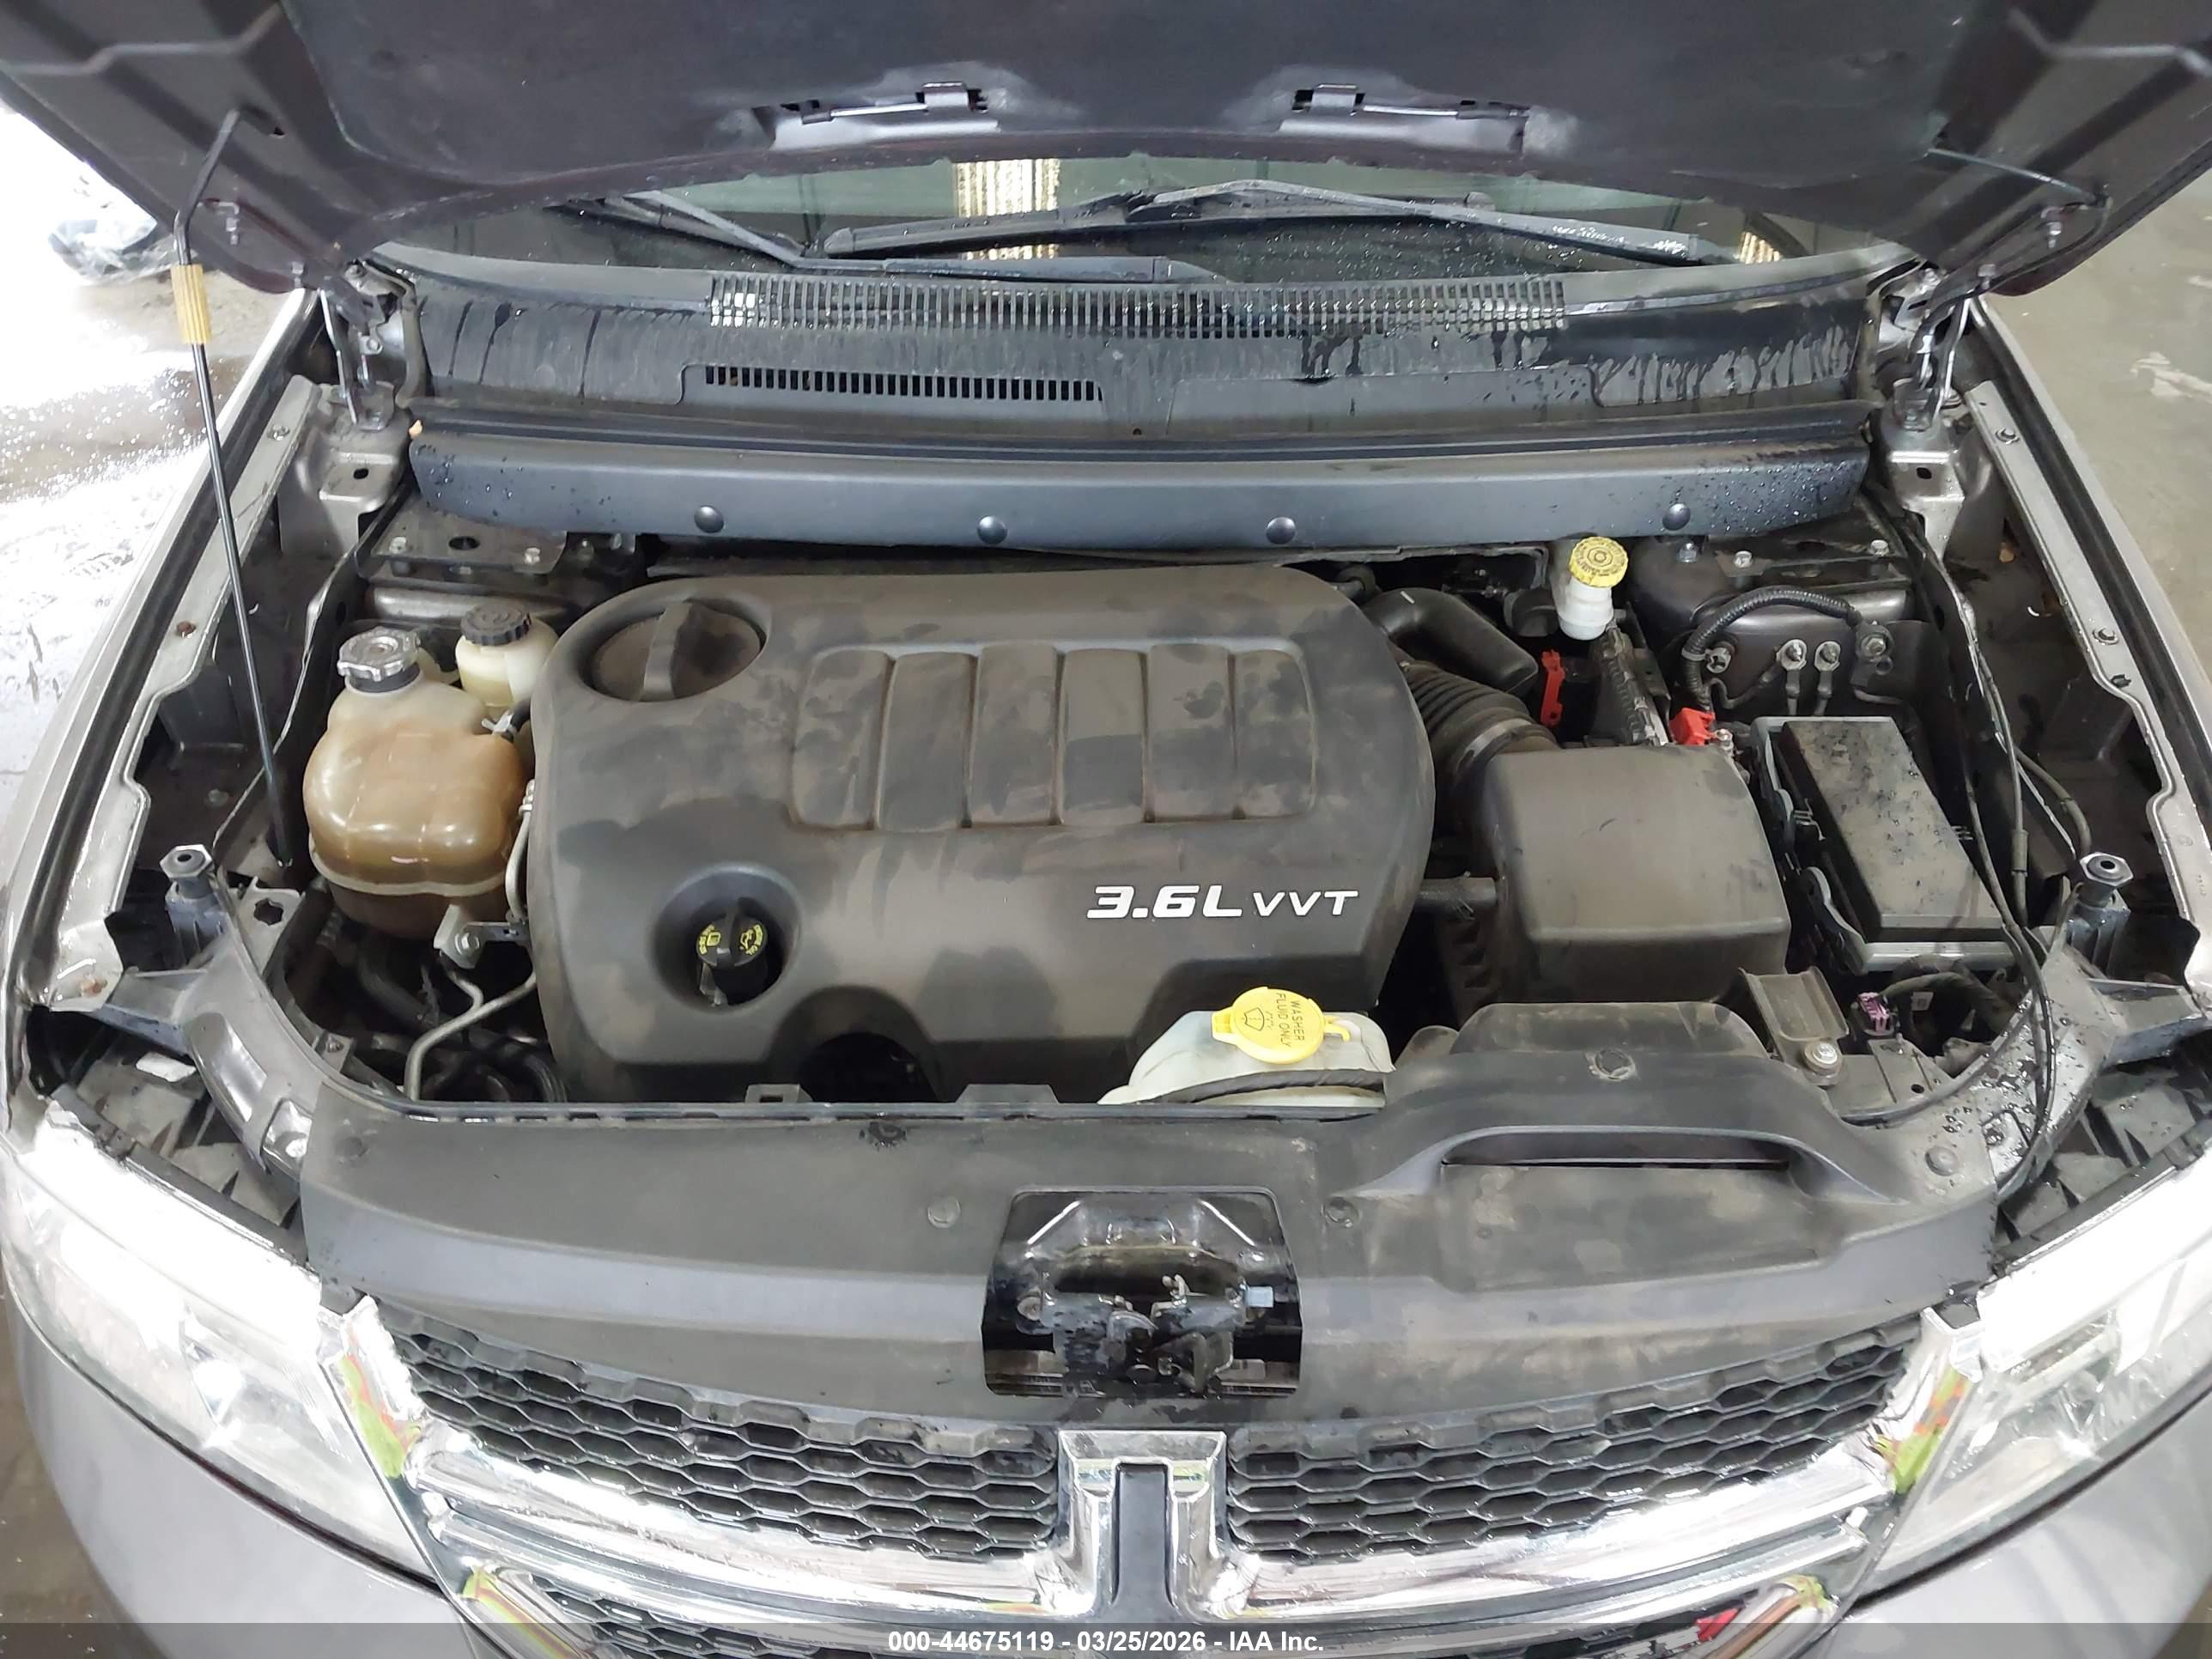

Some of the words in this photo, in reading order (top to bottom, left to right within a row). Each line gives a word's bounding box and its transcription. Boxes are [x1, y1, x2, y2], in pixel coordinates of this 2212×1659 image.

[1086, 884, 1243, 919] 3.6L
[1252, 890, 1359, 917] VVT
[1275, 993, 1289, 1020] FLUID
[1290, 1000, 1305, 1041] WASHER
[1279, 1021, 1292, 1048] ONLY
